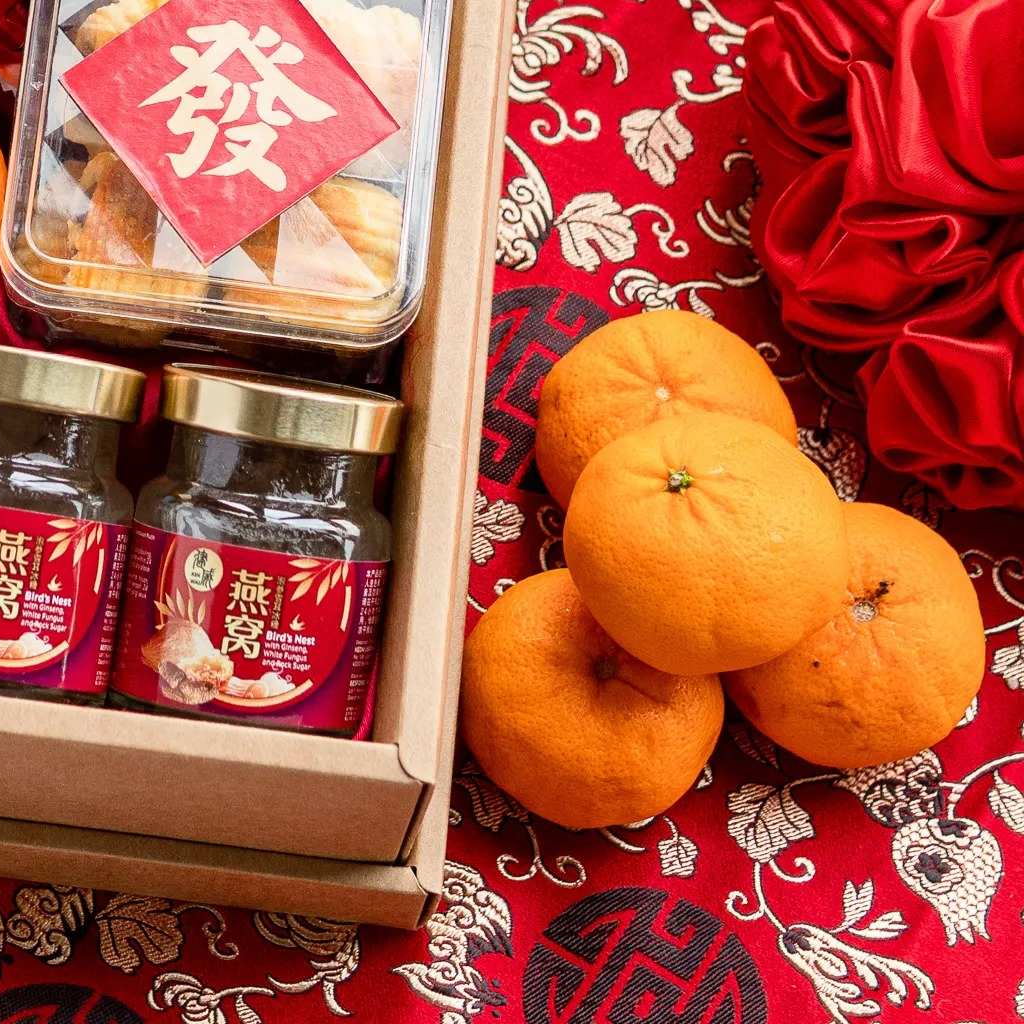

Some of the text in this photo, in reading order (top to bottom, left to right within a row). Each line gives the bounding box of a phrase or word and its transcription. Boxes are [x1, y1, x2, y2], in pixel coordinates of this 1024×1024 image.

[139, 20, 338, 192] 發
[24, 591, 72, 607] Bird's Nest
[23, 602, 64, 615] with Ginseng,
[220, 568, 273, 660] 燕窝
[22, 610, 64, 623] White Fungus
[50, 622, 67, 633] Sugar
[265, 631, 316, 646] Bird's Nest
[264, 642, 308, 655] with Ginseng,
[263, 650, 308, 663] White Fungus
[293, 662, 311, 672] Sugar
